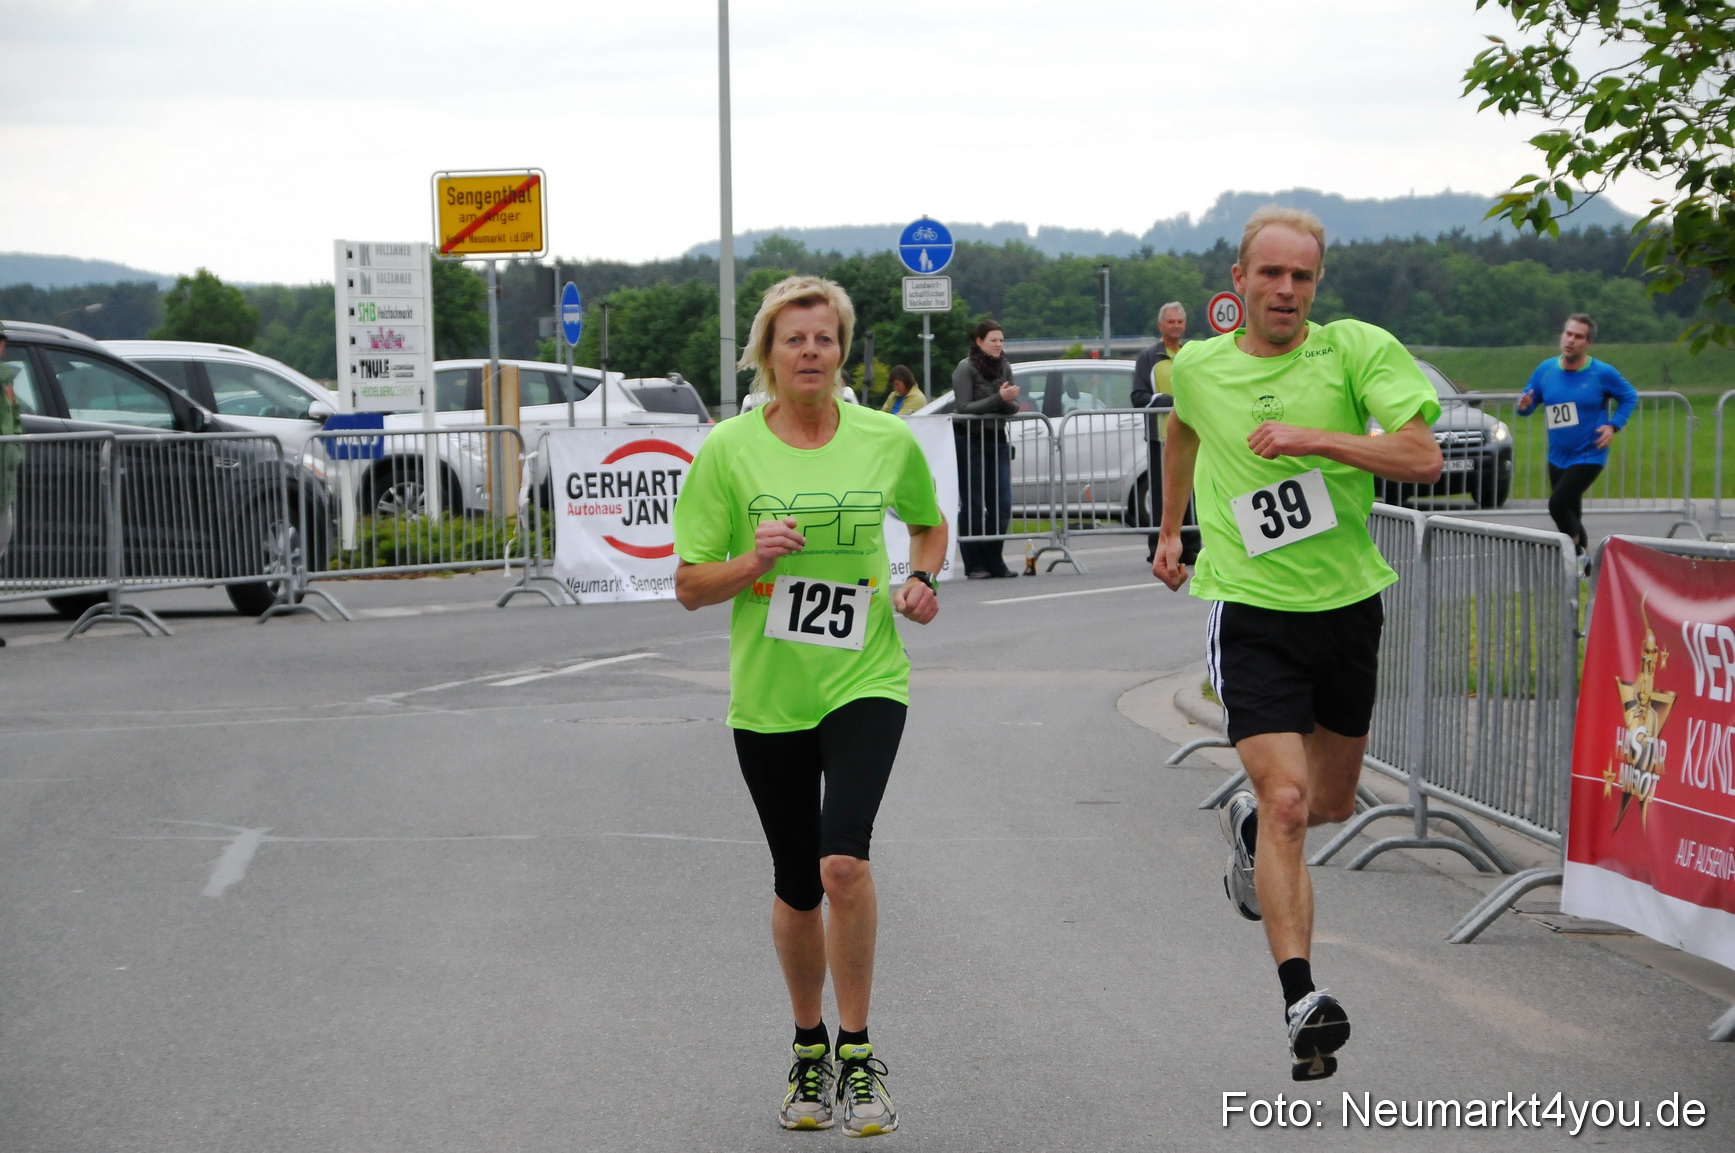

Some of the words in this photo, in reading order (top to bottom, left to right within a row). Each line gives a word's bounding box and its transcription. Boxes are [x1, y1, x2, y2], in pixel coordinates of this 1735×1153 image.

[446, 184, 532, 210] Sengenthal
[458, 213, 477, 223] am
[484, 211, 521, 225] Anger
[468, 233, 506, 244] Neumarkt
[911, 280, 942, 289] Landwirt-
[358, 301, 377, 323] SHB
[1215, 303, 1236, 323] 60
[1305, 346, 1334, 359] DEKRA
[359, 359, 389, 379] THULE
[1552, 404, 1571, 425] 20
[566, 469, 683, 500] GERHART
[567, 502, 623, 516] Autohaus
[622, 497, 678, 527] JÄN
[1251, 479, 1312, 539] 39
[565, 573, 624, 594] Neumarkt
[629, 571, 678, 595] Sengent
[787, 581, 857, 639] 125
[1674, 838, 1697, 869] AUF
